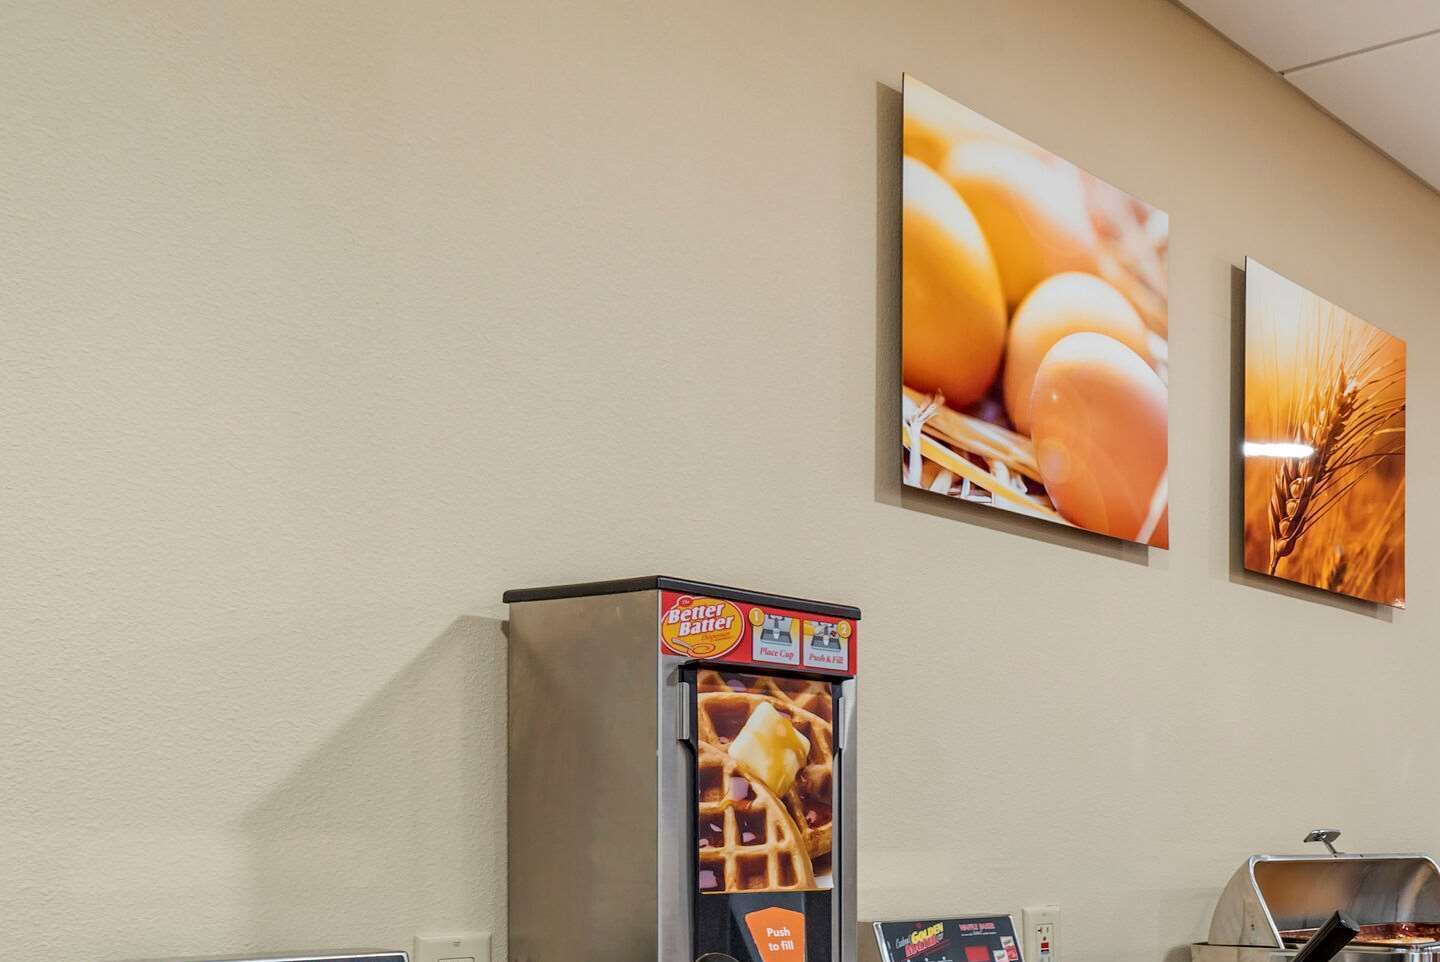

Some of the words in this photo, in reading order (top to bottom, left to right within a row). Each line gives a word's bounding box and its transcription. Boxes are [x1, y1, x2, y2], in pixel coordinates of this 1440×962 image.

[668, 603, 725, 624] Better
[679, 616, 735, 637] Batter
[760, 647, 778, 657] Place
[779, 650, 795, 660] Cup
[766, 927, 791, 938] Push
[768, 942, 780, 951] to
[781, 940, 795, 951] fill
